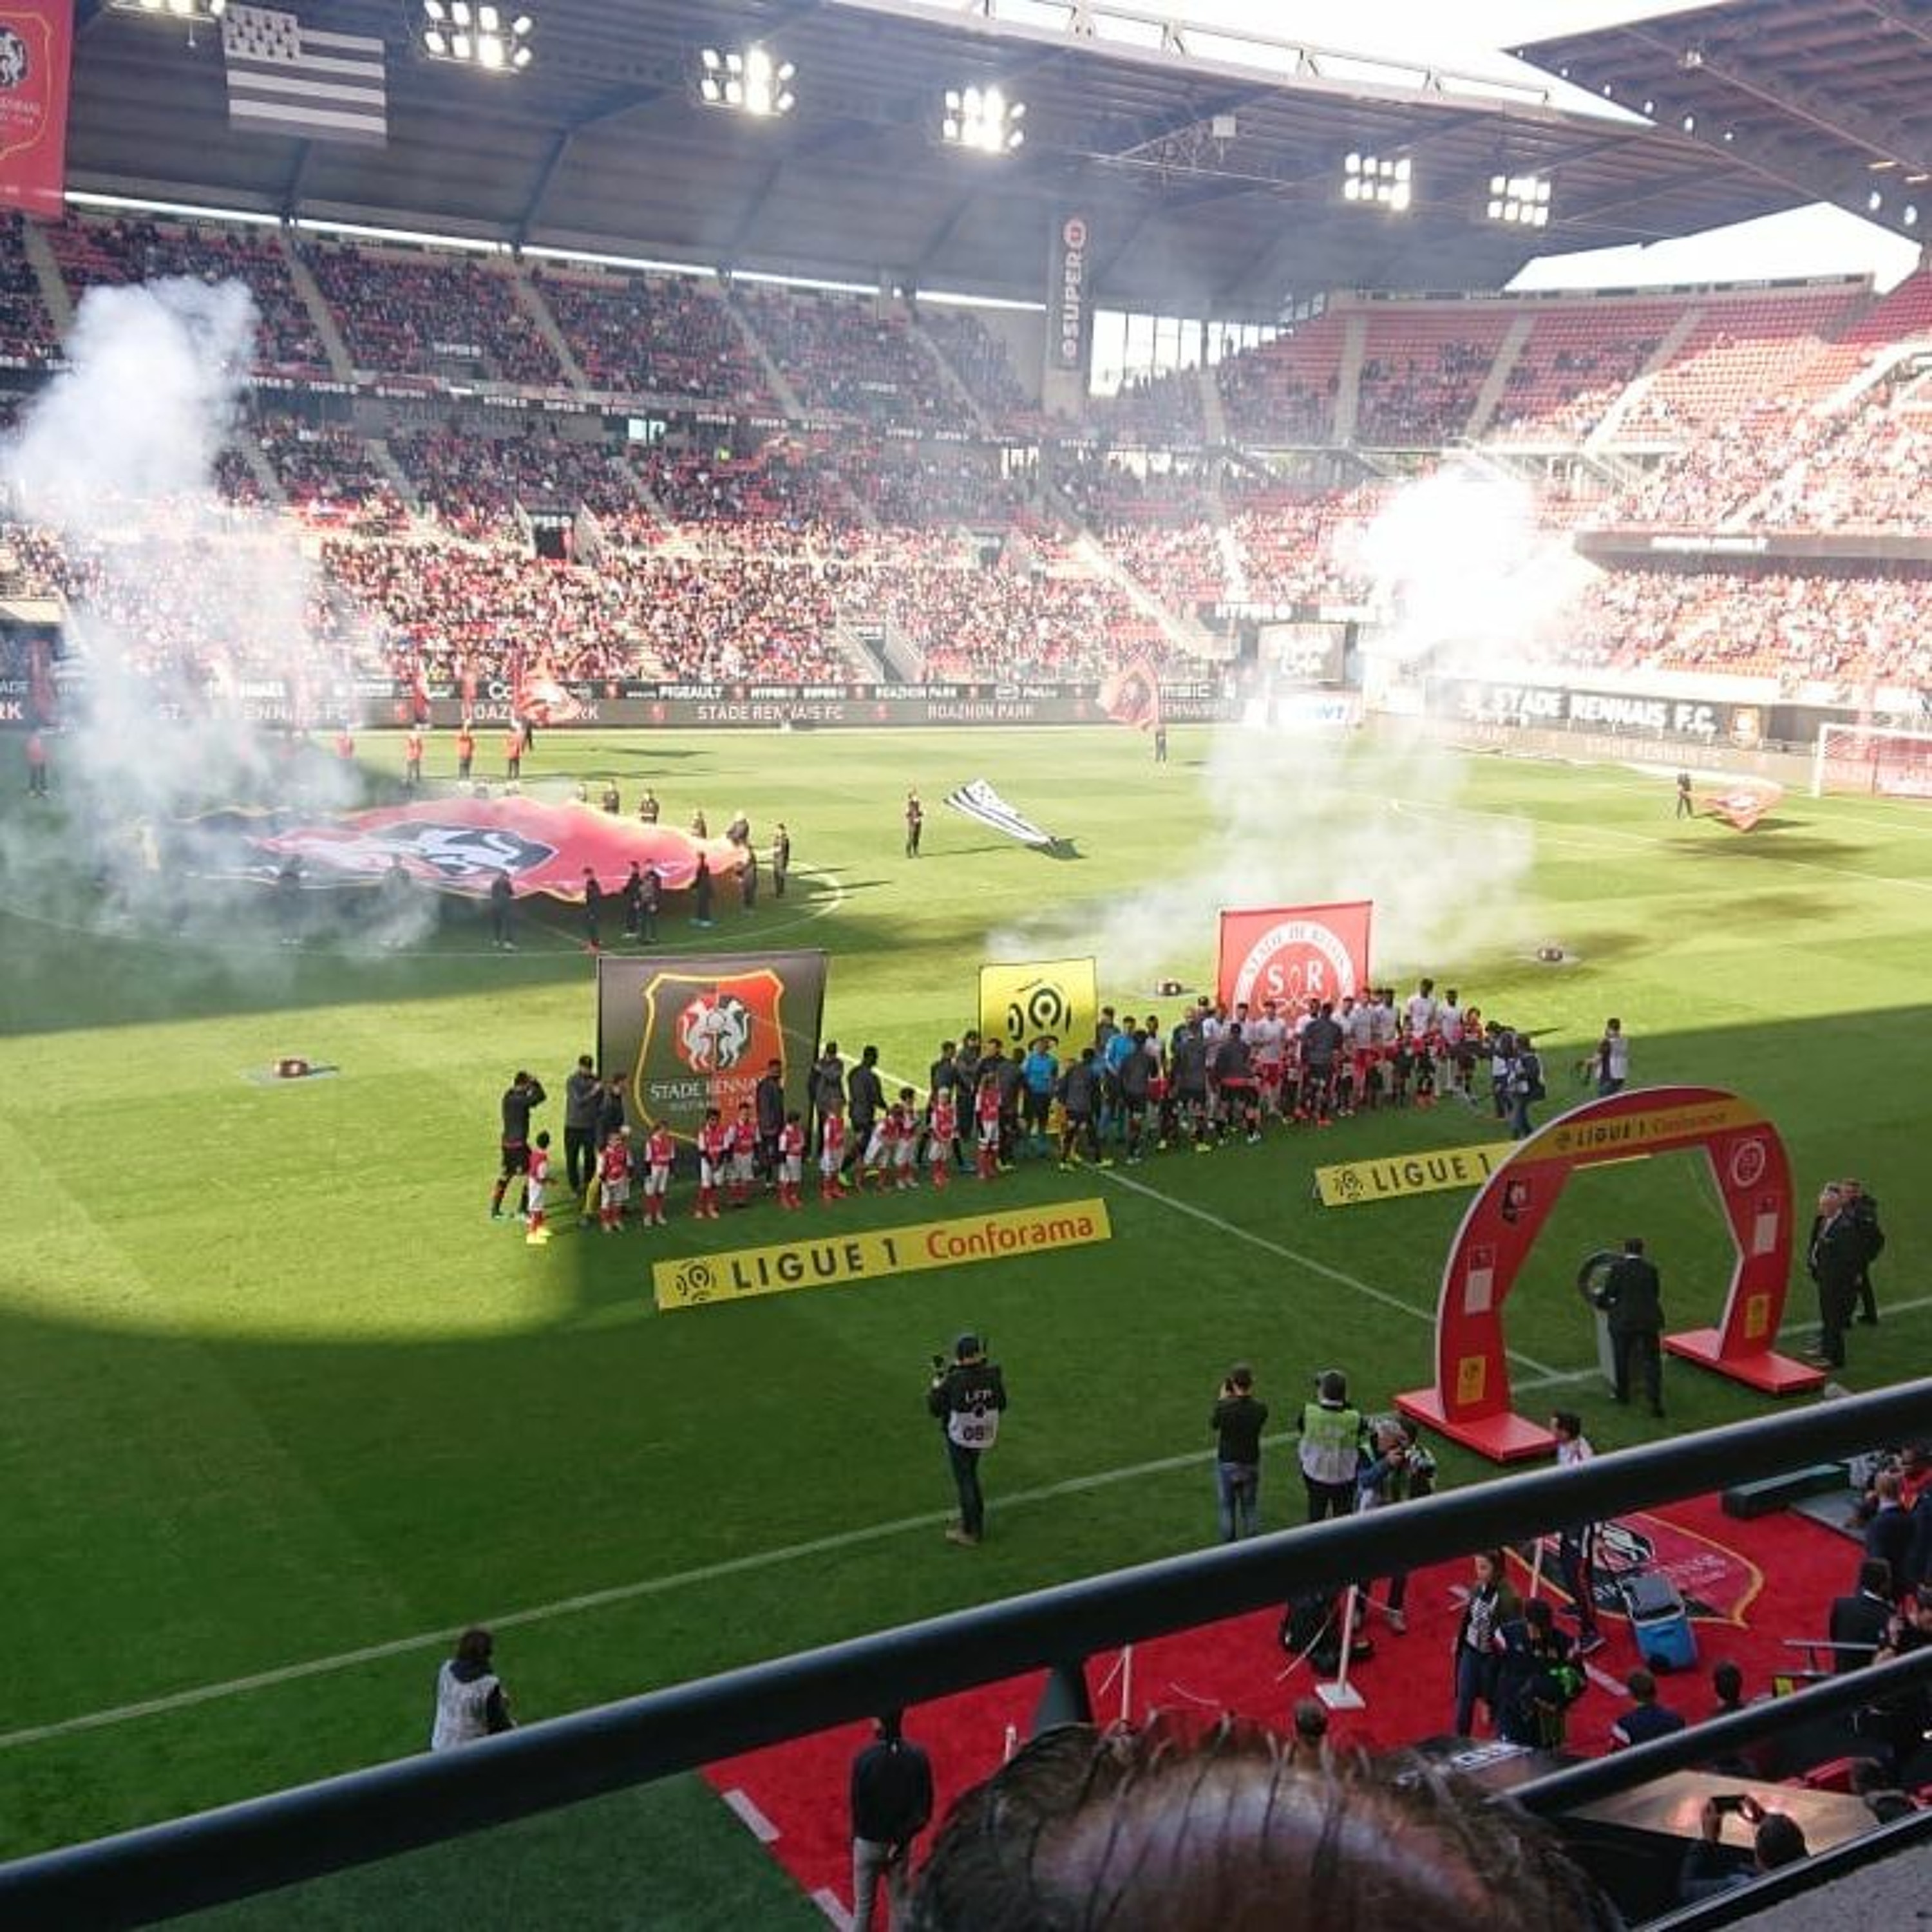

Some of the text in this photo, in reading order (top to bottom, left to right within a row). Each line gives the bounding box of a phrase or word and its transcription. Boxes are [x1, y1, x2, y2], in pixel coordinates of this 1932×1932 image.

[1063, 250, 1082, 339] SUPER
[697, 705, 748, 720] STADE
[1569, 694, 1667, 729] RENNAIS
[650, 1082, 701, 1100] STADE
[1577, 1119, 1631, 1147] LIGUE
[1372, 1153, 1491, 1191] LIGUE 1
[730, 1214, 1094, 1289] LIGUE 1 Conforama
